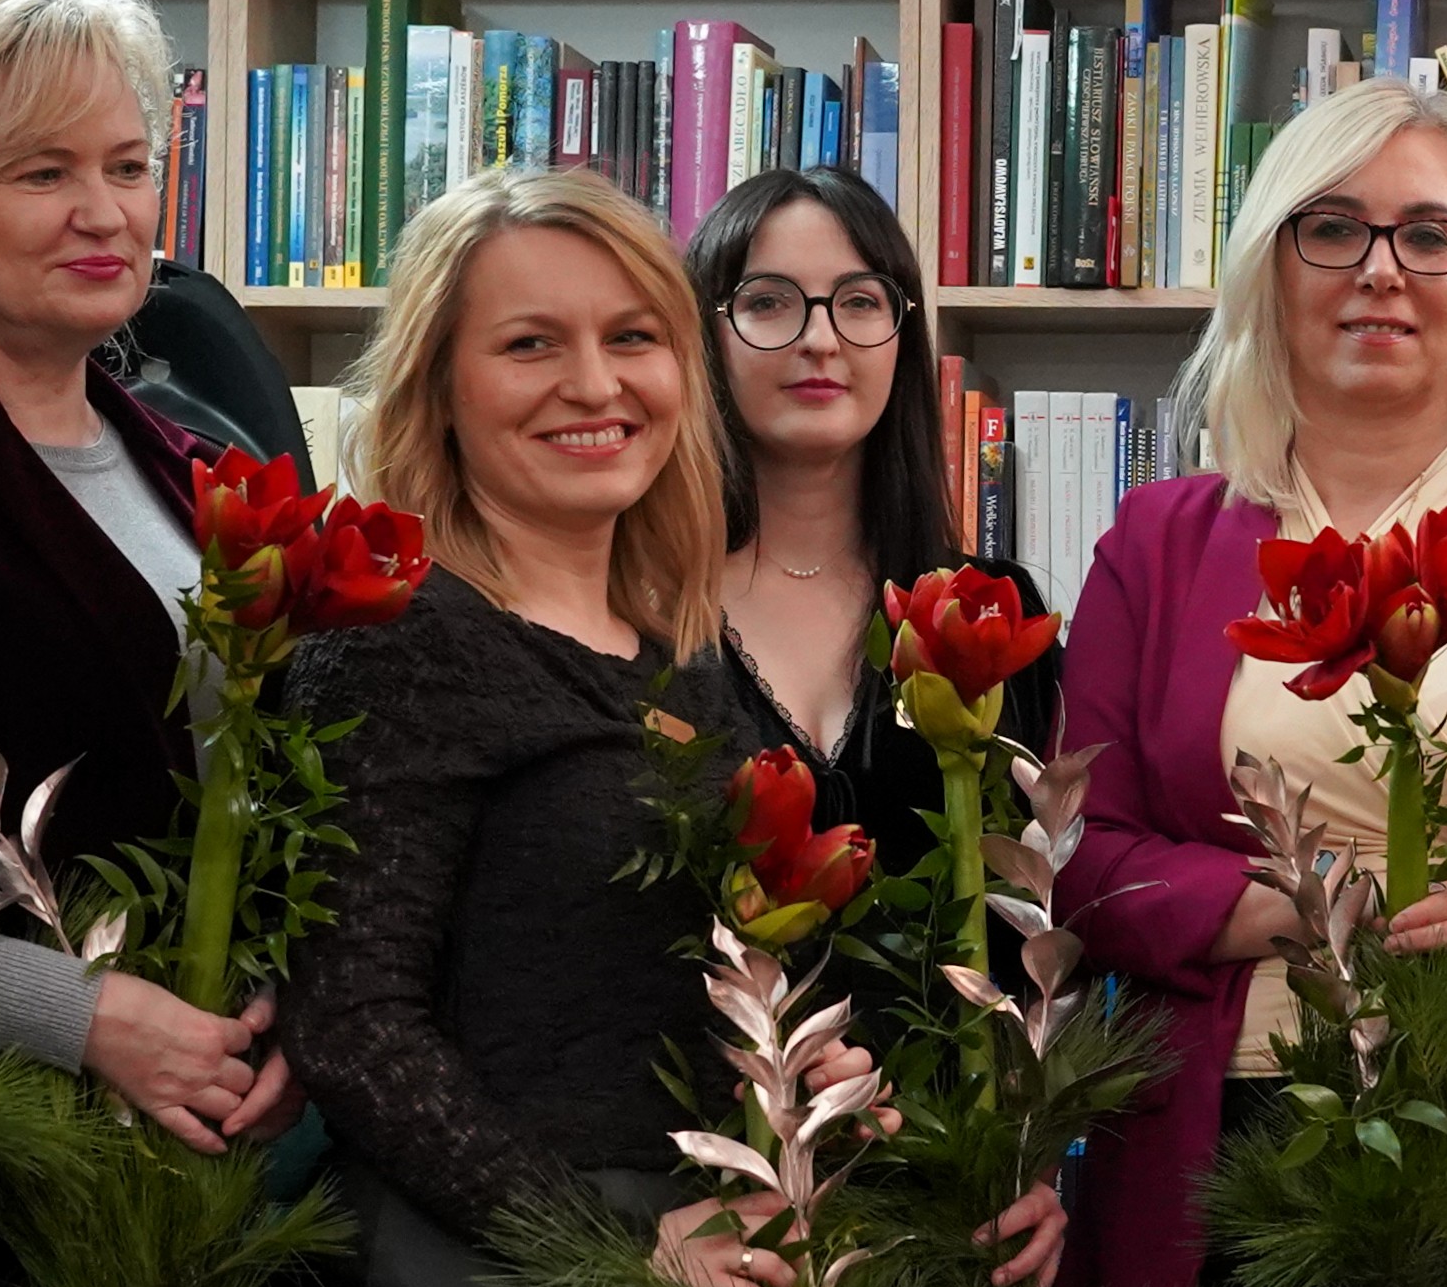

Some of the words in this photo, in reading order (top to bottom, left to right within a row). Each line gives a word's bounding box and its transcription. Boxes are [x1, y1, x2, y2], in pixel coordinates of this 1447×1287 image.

[734, 75, 749, 152] ABECADŁO
[1194, 38, 1211, 159] WEJHEROWSKA
[993, 157, 1008, 251] WŁADYSŁAWOWO
[1193, 166, 1207, 224] ZIEMIA
[986, 419, 999, 437] F
